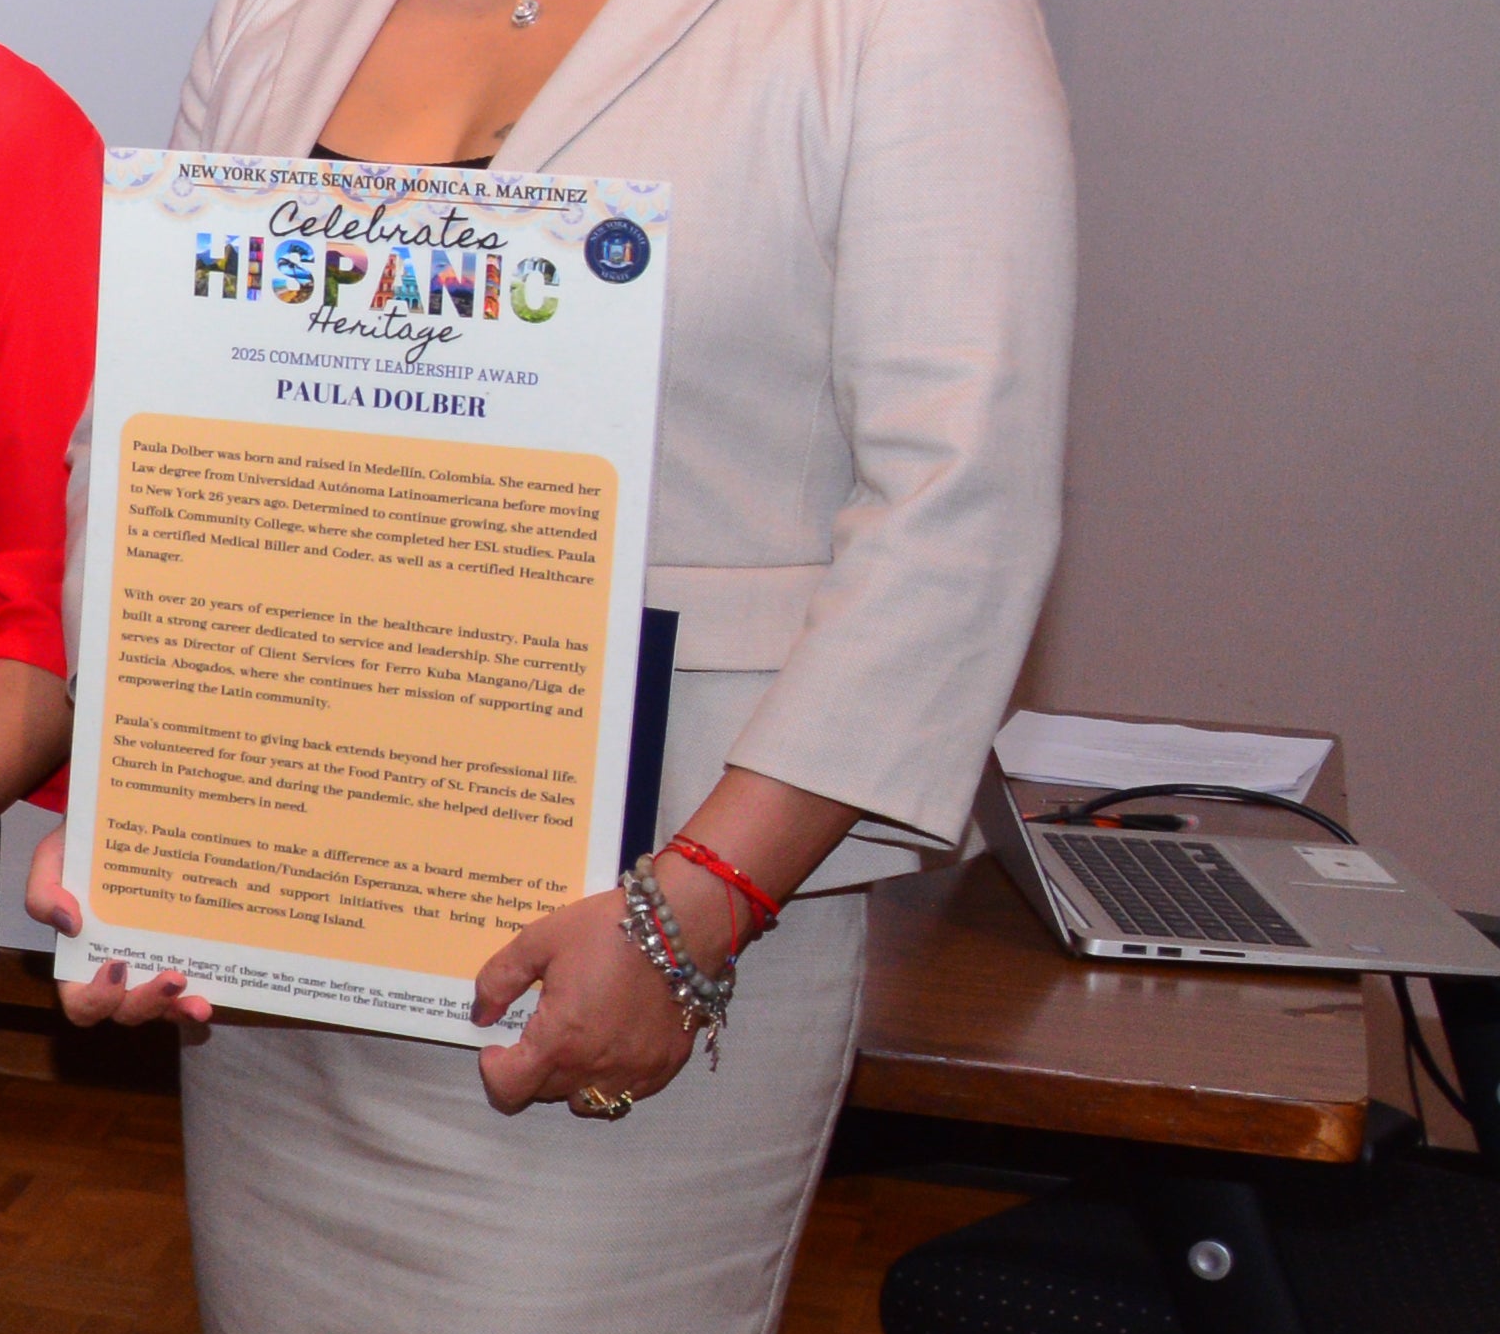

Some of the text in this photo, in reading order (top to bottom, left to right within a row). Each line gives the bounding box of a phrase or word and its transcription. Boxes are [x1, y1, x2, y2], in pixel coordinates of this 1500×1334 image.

[178, 163, 588, 204] NEW YORK STATE SENATOR MONICA R. MARTINEZ
[268, 200, 508, 252] Celebrates
[194, 233, 561, 322] HISPANIC
[308, 302, 462, 364] Heritage
[230, 346, 539, 386] 2025 COMMUNITY LEADERSHIP AWARD
[275, 379, 489, 418] PAULA DOLBER
[131, 461, 156, 473] Law
[158, 463, 202, 480] degree
[204, 468, 235, 482] from
[237, 471, 315, 489] Universidad
[388, 486, 499, 508] Latinoamericana
[502, 498, 546, 513] before
[548, 503, 600, 521] moving
[132, 440, 168, 453] Paula
[170, 444, 215, 458] Dolber
[216, 451, 241, 460] was
[243, 450, 275, 464] born
[277, 454, 302, 466] and
[305, 456, 346, 471] raised
[348, 461, 362, 473] in
[498, 475, 524, 488] She
[526, 478, 574, 493] earned
[577, 483, 602, 496] her
